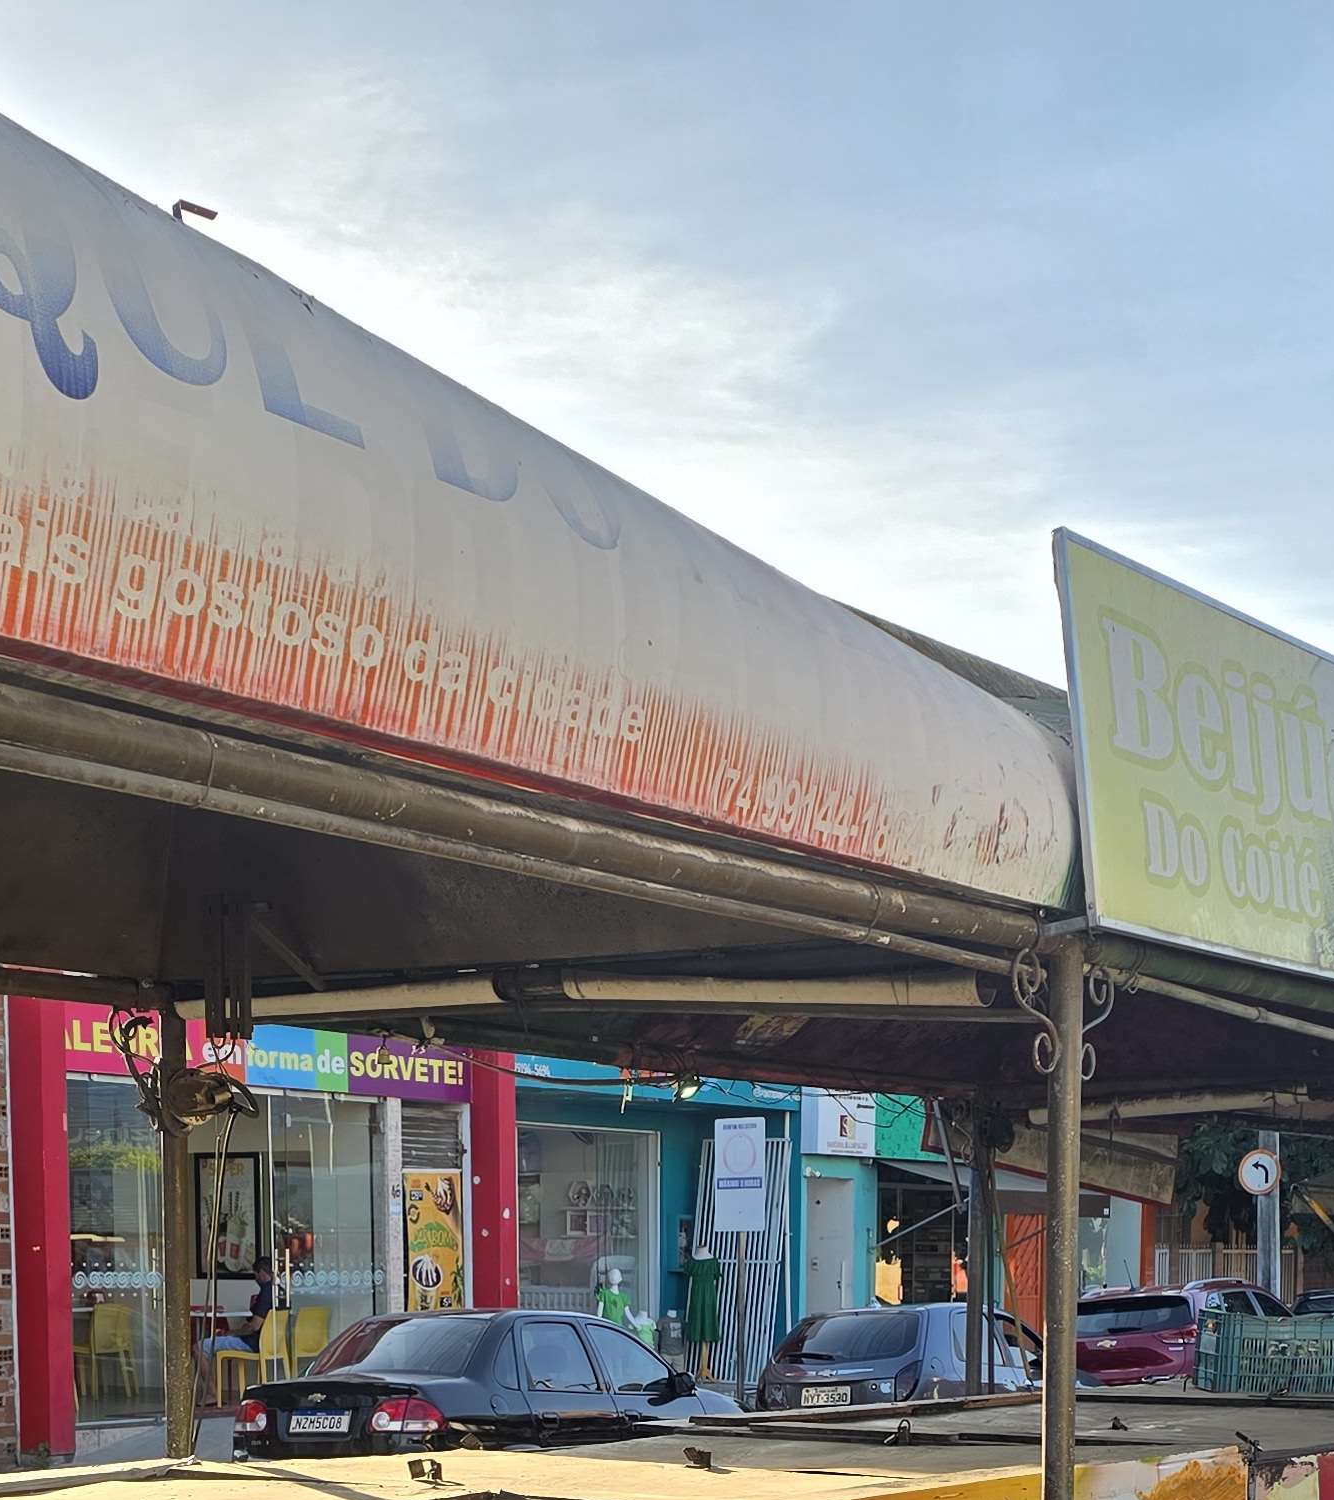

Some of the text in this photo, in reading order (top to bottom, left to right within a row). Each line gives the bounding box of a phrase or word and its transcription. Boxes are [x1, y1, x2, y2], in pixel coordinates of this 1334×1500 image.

[115, 553, 385, 668] gostoso
[404, 629, 468, 694] da
[1142, 801, 1209, 888] Do
[246, 1039, 313, 1073] forma
[317, 1048, 345, 1075] de
[349, 1051, 464, 1085] SORVETE!
